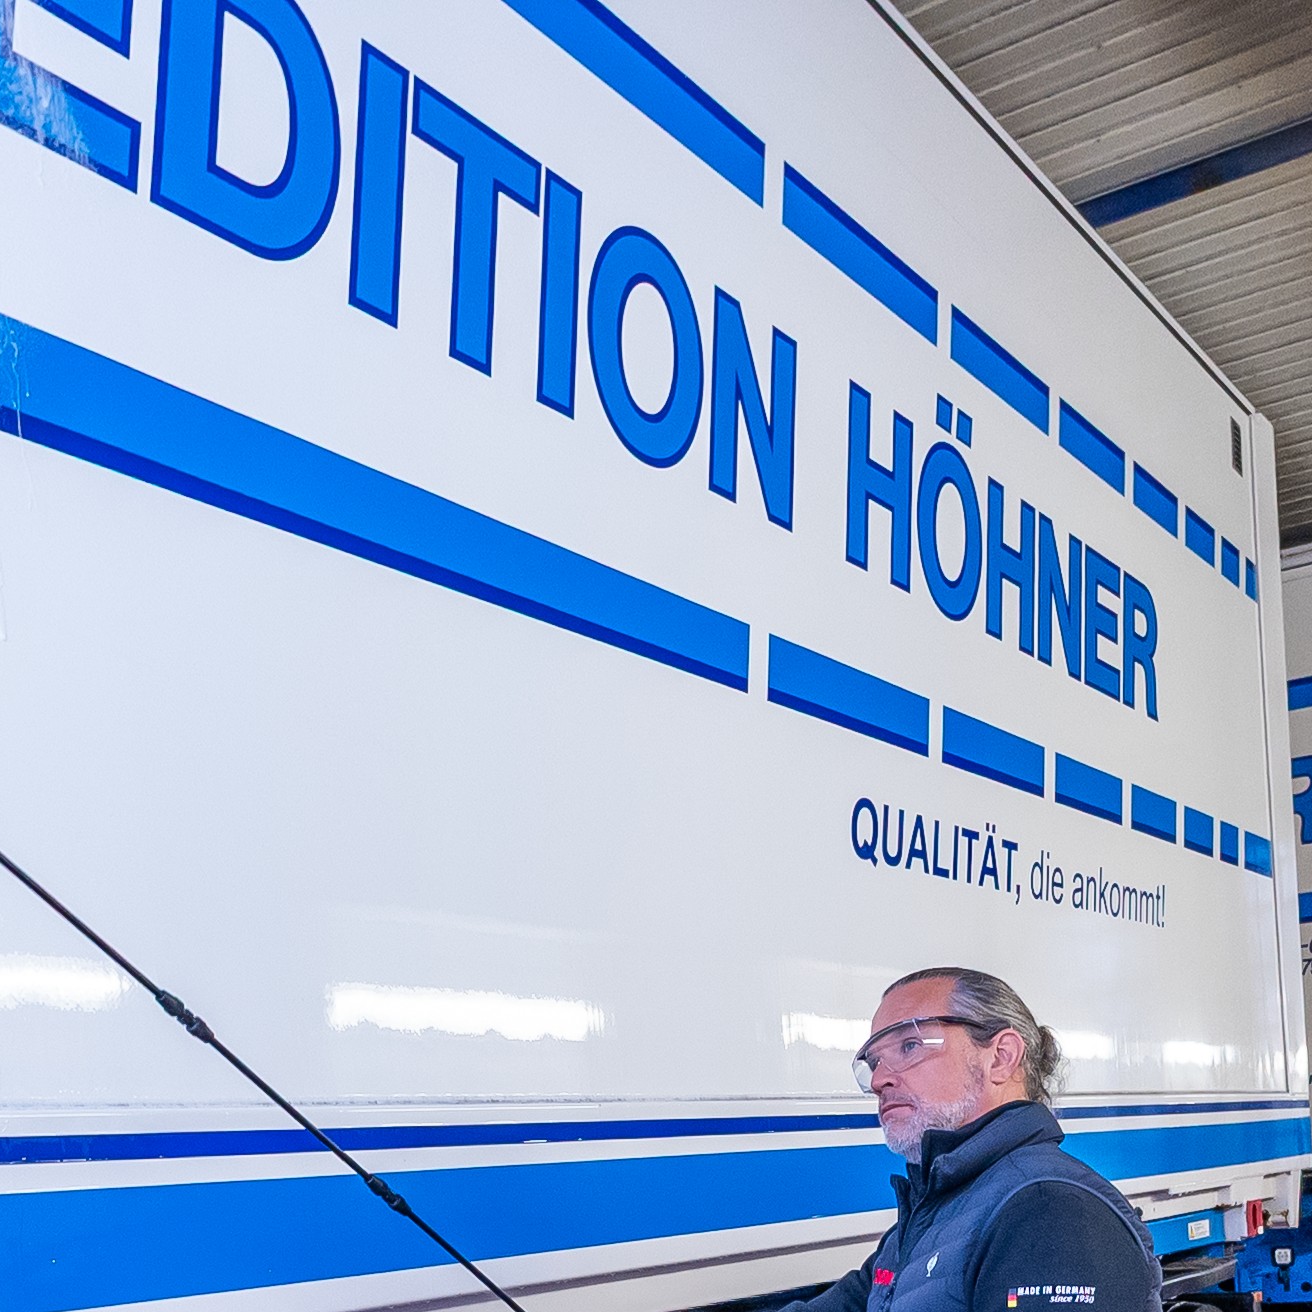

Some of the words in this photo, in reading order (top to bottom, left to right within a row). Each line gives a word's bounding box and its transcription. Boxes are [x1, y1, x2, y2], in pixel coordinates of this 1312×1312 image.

[845, 379, 1160, 722] HÖHNER
[851, 797, 1021, 905] QUALITÄT,
[1030, 850, 1064, 904] die
[1072, 866, 1166, 928] ankommt!
[1017, 1286, 1040, 1296] MADE
[1043, 1285, 1053, 1295] IN
[1055, 1285, 1096, 1295] GERMANY
[1049, 1295, 1073, 1303] since
